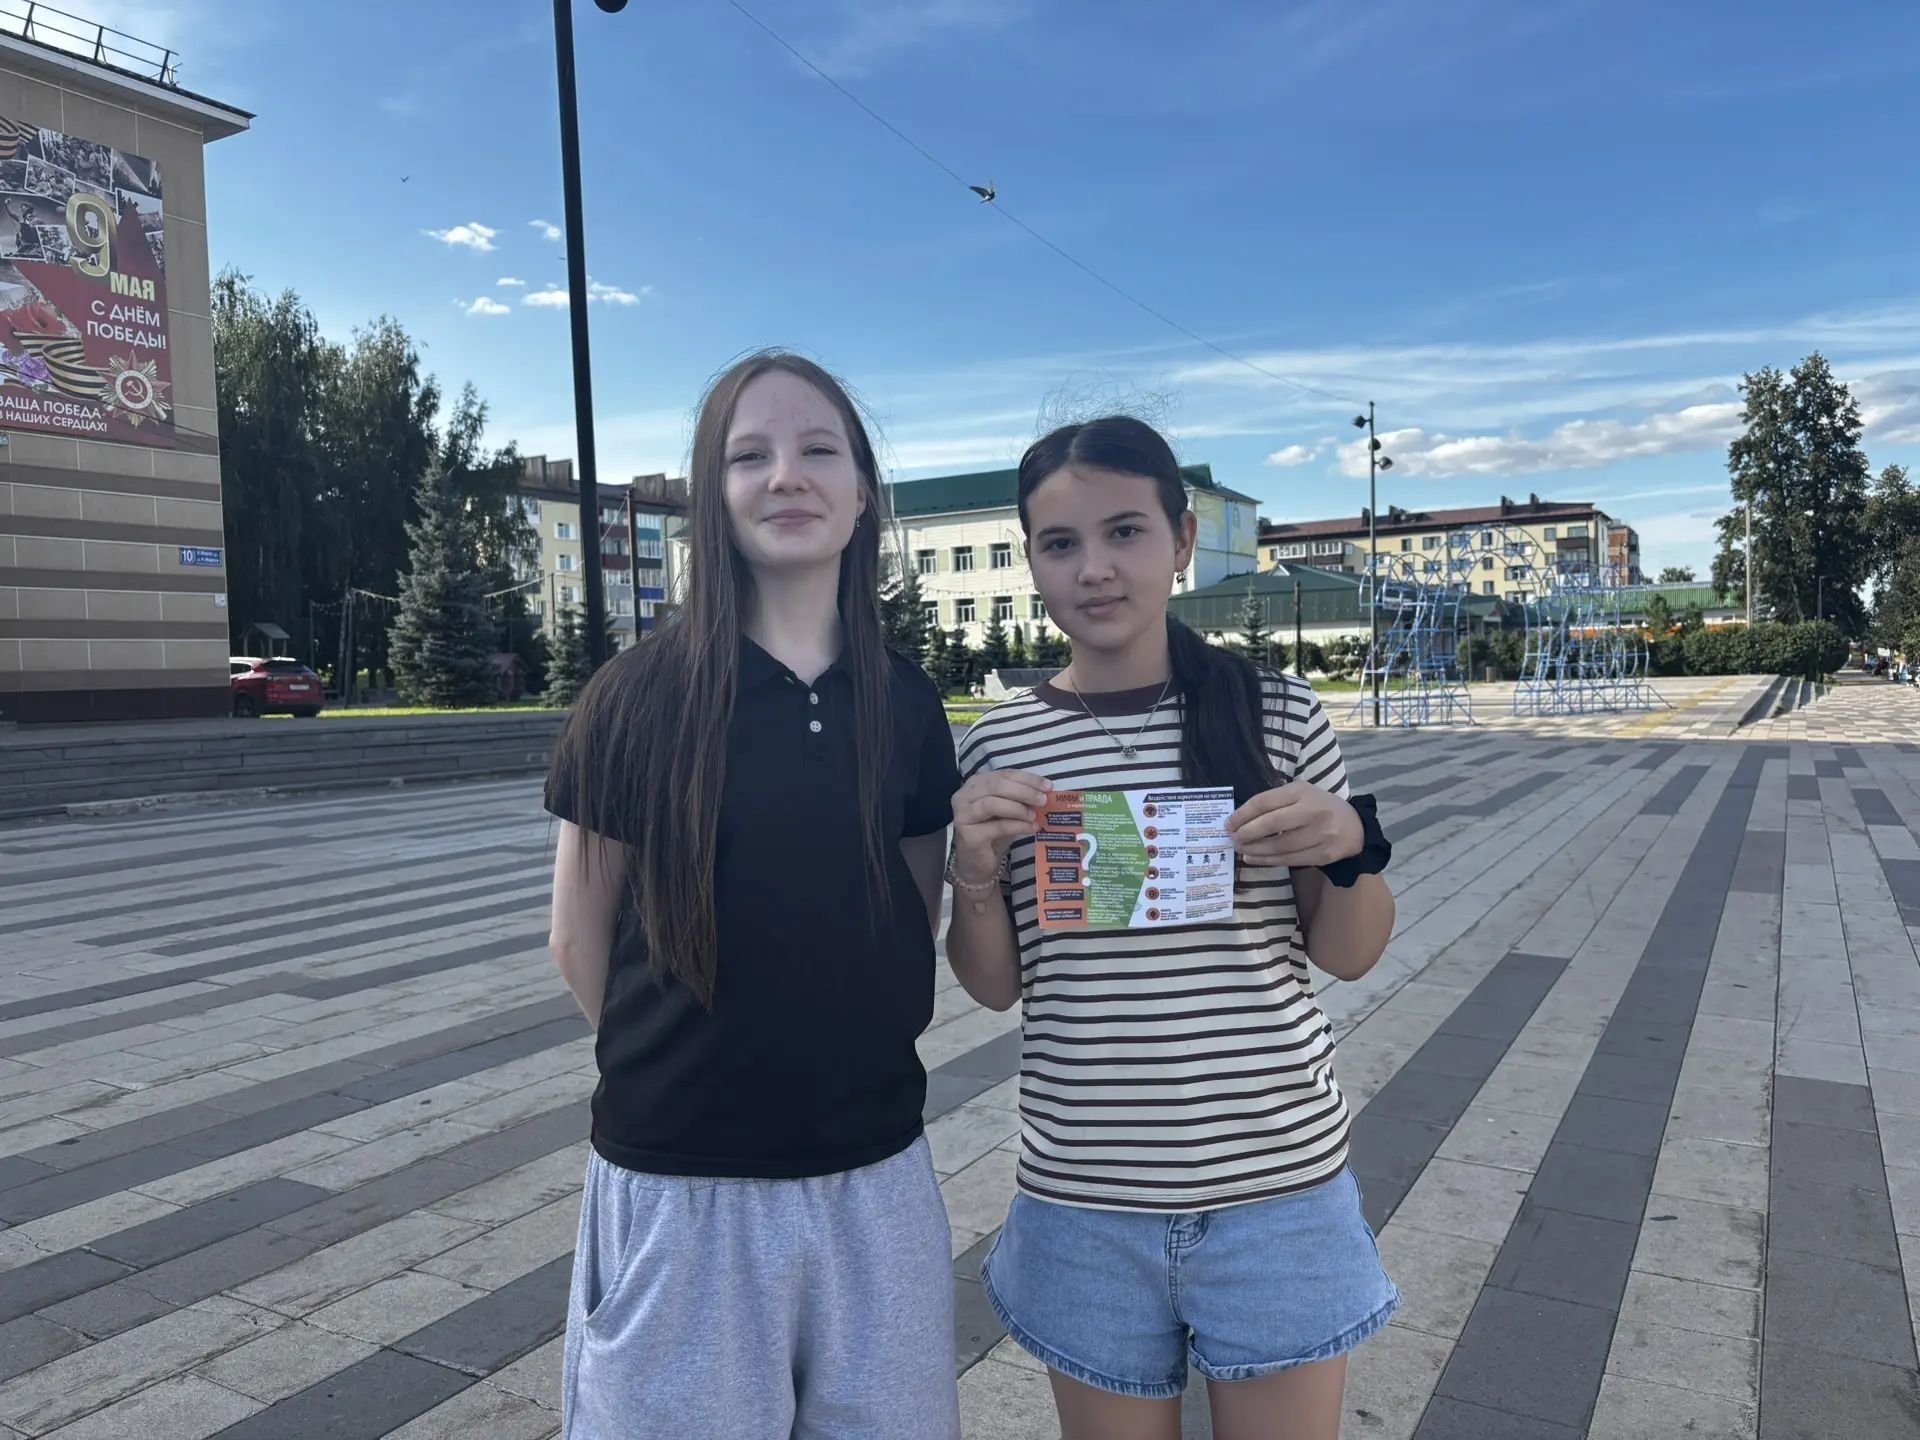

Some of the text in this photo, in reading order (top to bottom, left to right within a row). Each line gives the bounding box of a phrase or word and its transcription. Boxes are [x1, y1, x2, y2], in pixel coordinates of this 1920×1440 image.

[66, 192, 155, 302] 9 МАЯ
[91, 300, 160, 328] С ДНЁМ
[87, 320, 167, 350] ПОБЕДЫ!
[6, 410, 50, 425] НАШИХ
[52, 416, 108, 432] СЕРДЦАХ!
[43, 400, 102, 420] ПОБЕДА
[182, 549, 193, 562] 10
[1085, 793, 1112, 804] ПРАВДА
